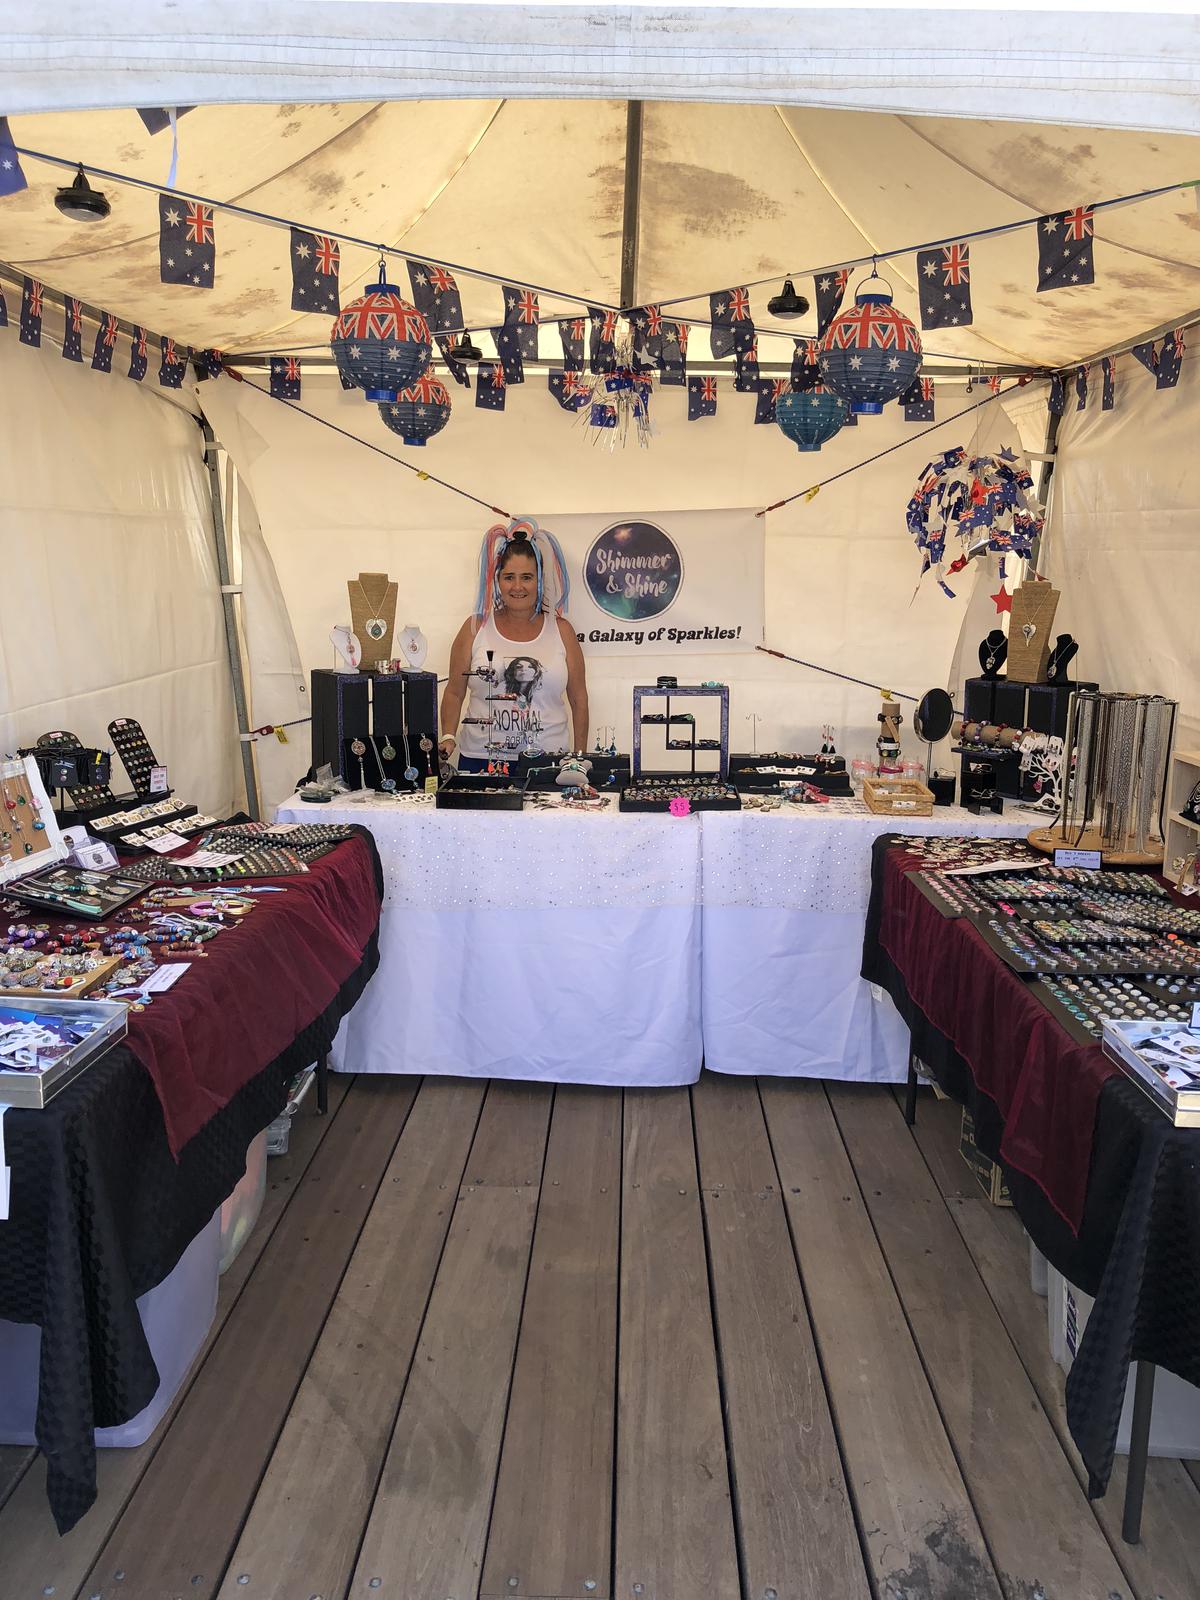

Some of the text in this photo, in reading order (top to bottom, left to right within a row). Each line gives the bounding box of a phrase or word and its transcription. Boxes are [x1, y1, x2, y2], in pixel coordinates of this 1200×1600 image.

[596, 548, 672, 574] Shimmer
[605, 573, 668, 599] & Shine
[589, 629, 644, 645] Galaxy
[648, 627, 666, 641] of
[667, 626, 742, 644] Sparkles!
[494, 709, 544, 731] NORMAL
